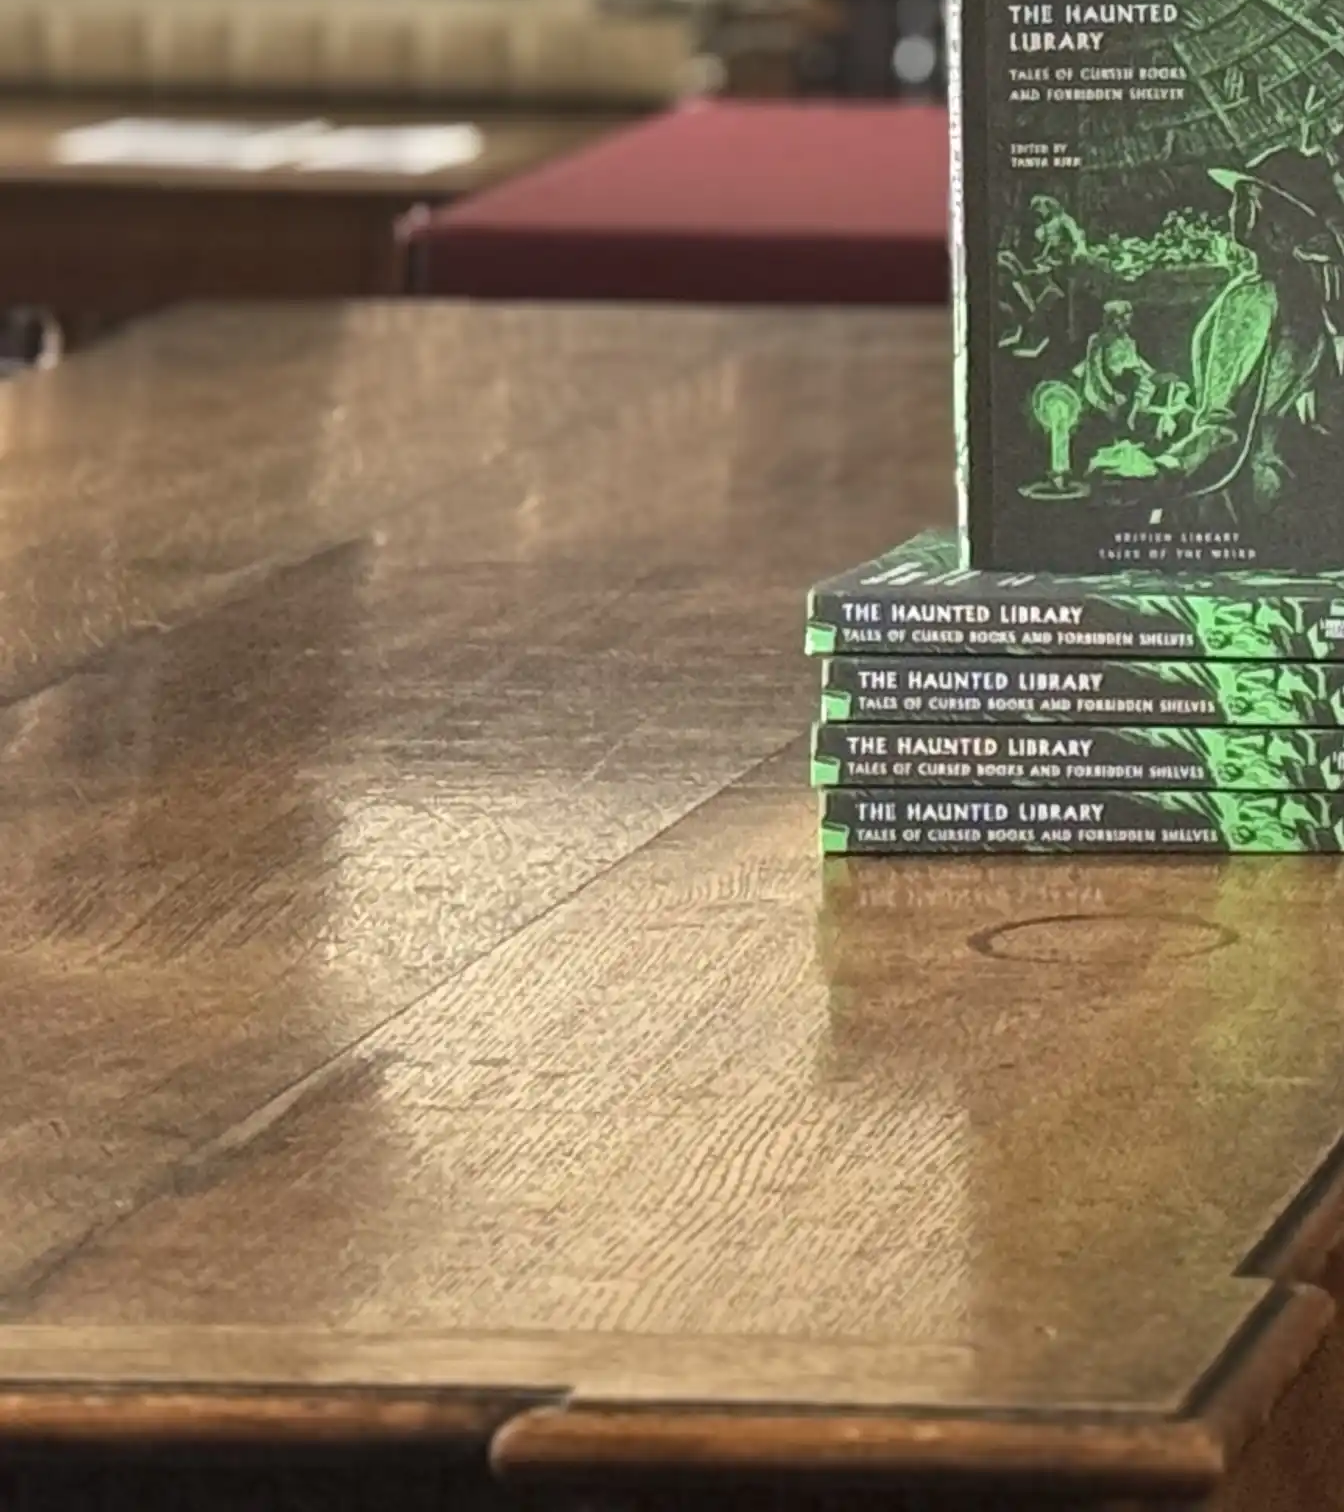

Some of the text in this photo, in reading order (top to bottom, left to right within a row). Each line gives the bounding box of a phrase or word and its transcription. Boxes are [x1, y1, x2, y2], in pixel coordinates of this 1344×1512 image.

[1008, 3, 1178, 25] THE HAUNTED
[1009, 31, 1104, 52] LIBRARY
[1009, 66, 1050, 81] TALES
[1055, 67, 1074, 81] OF
[1138, 66, 1187, 81] BOOKS
[1008, 88, 1040, 101] AND
[1047, 87, 1123, 101] FORBIDDEN
[842, 603, 1083, 625] THE HAUNTED LIBRARY
[843, 628, 1194, 648] TALES OF CURSED BOOKS AND FORBIDDEN SHELVES
[858, 671, 1104, 692] THE HAUNTED LIBRARY
[858, 696, 1215, 714] TALES OF CURSED BOOKS AND FORBIDDEN SHELVES
[846, 736, 1094, 757] THE HAUNTED LIBRARY
[847, 761, 1204, 780] TALES OF CURSED BOOKS AND FORBIDDEN SHELVES
[856, 803, 1104, 822] THE HAUNTED LIBRARY
[856, 828, 1218, 842] TALES OF CURSED BOOKS AND FORBIDDEN SHELVES
